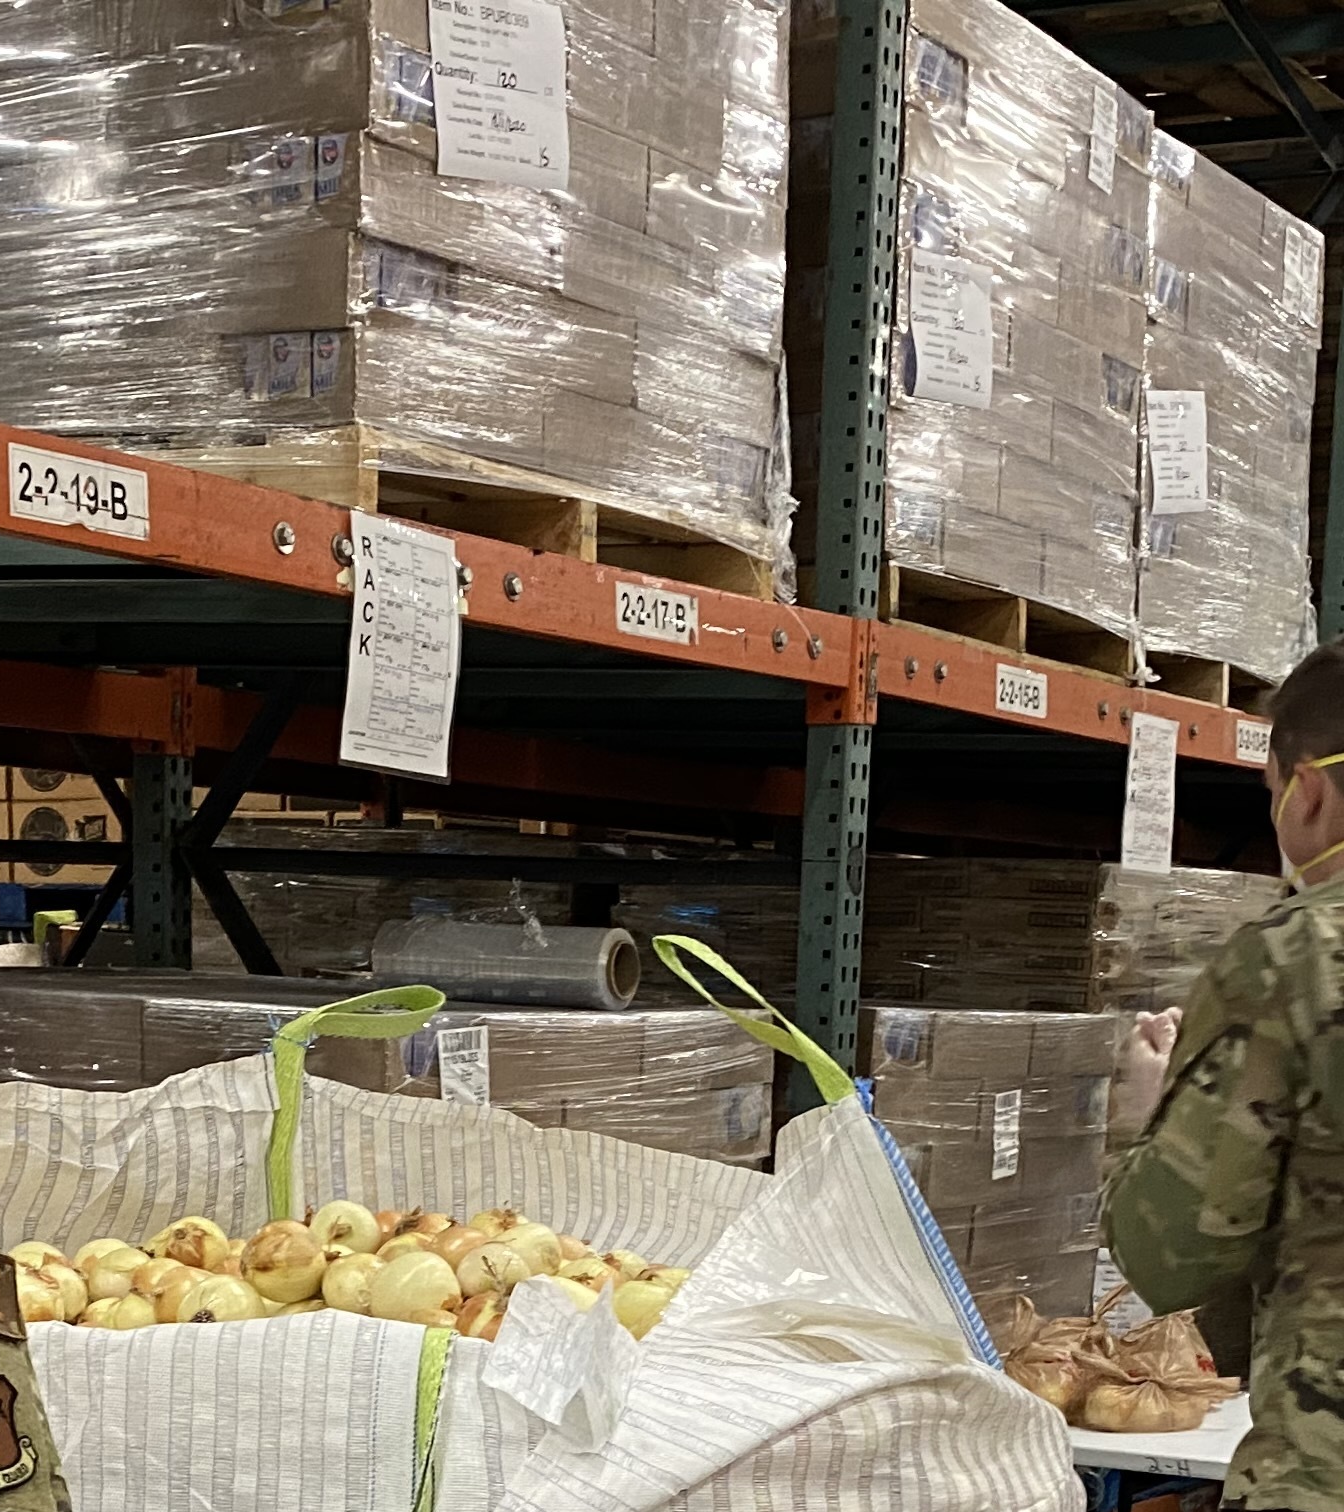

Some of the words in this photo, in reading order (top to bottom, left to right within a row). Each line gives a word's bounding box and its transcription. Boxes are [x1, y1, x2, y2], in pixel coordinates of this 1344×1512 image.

[19, 461, 127, 520] 2-2-19-B
[358, 535, 376, 657] RACK
[621, 592, 686, 633] 2-2-17-B
[1000, 678, 1040, 710] 2-2-15-B
